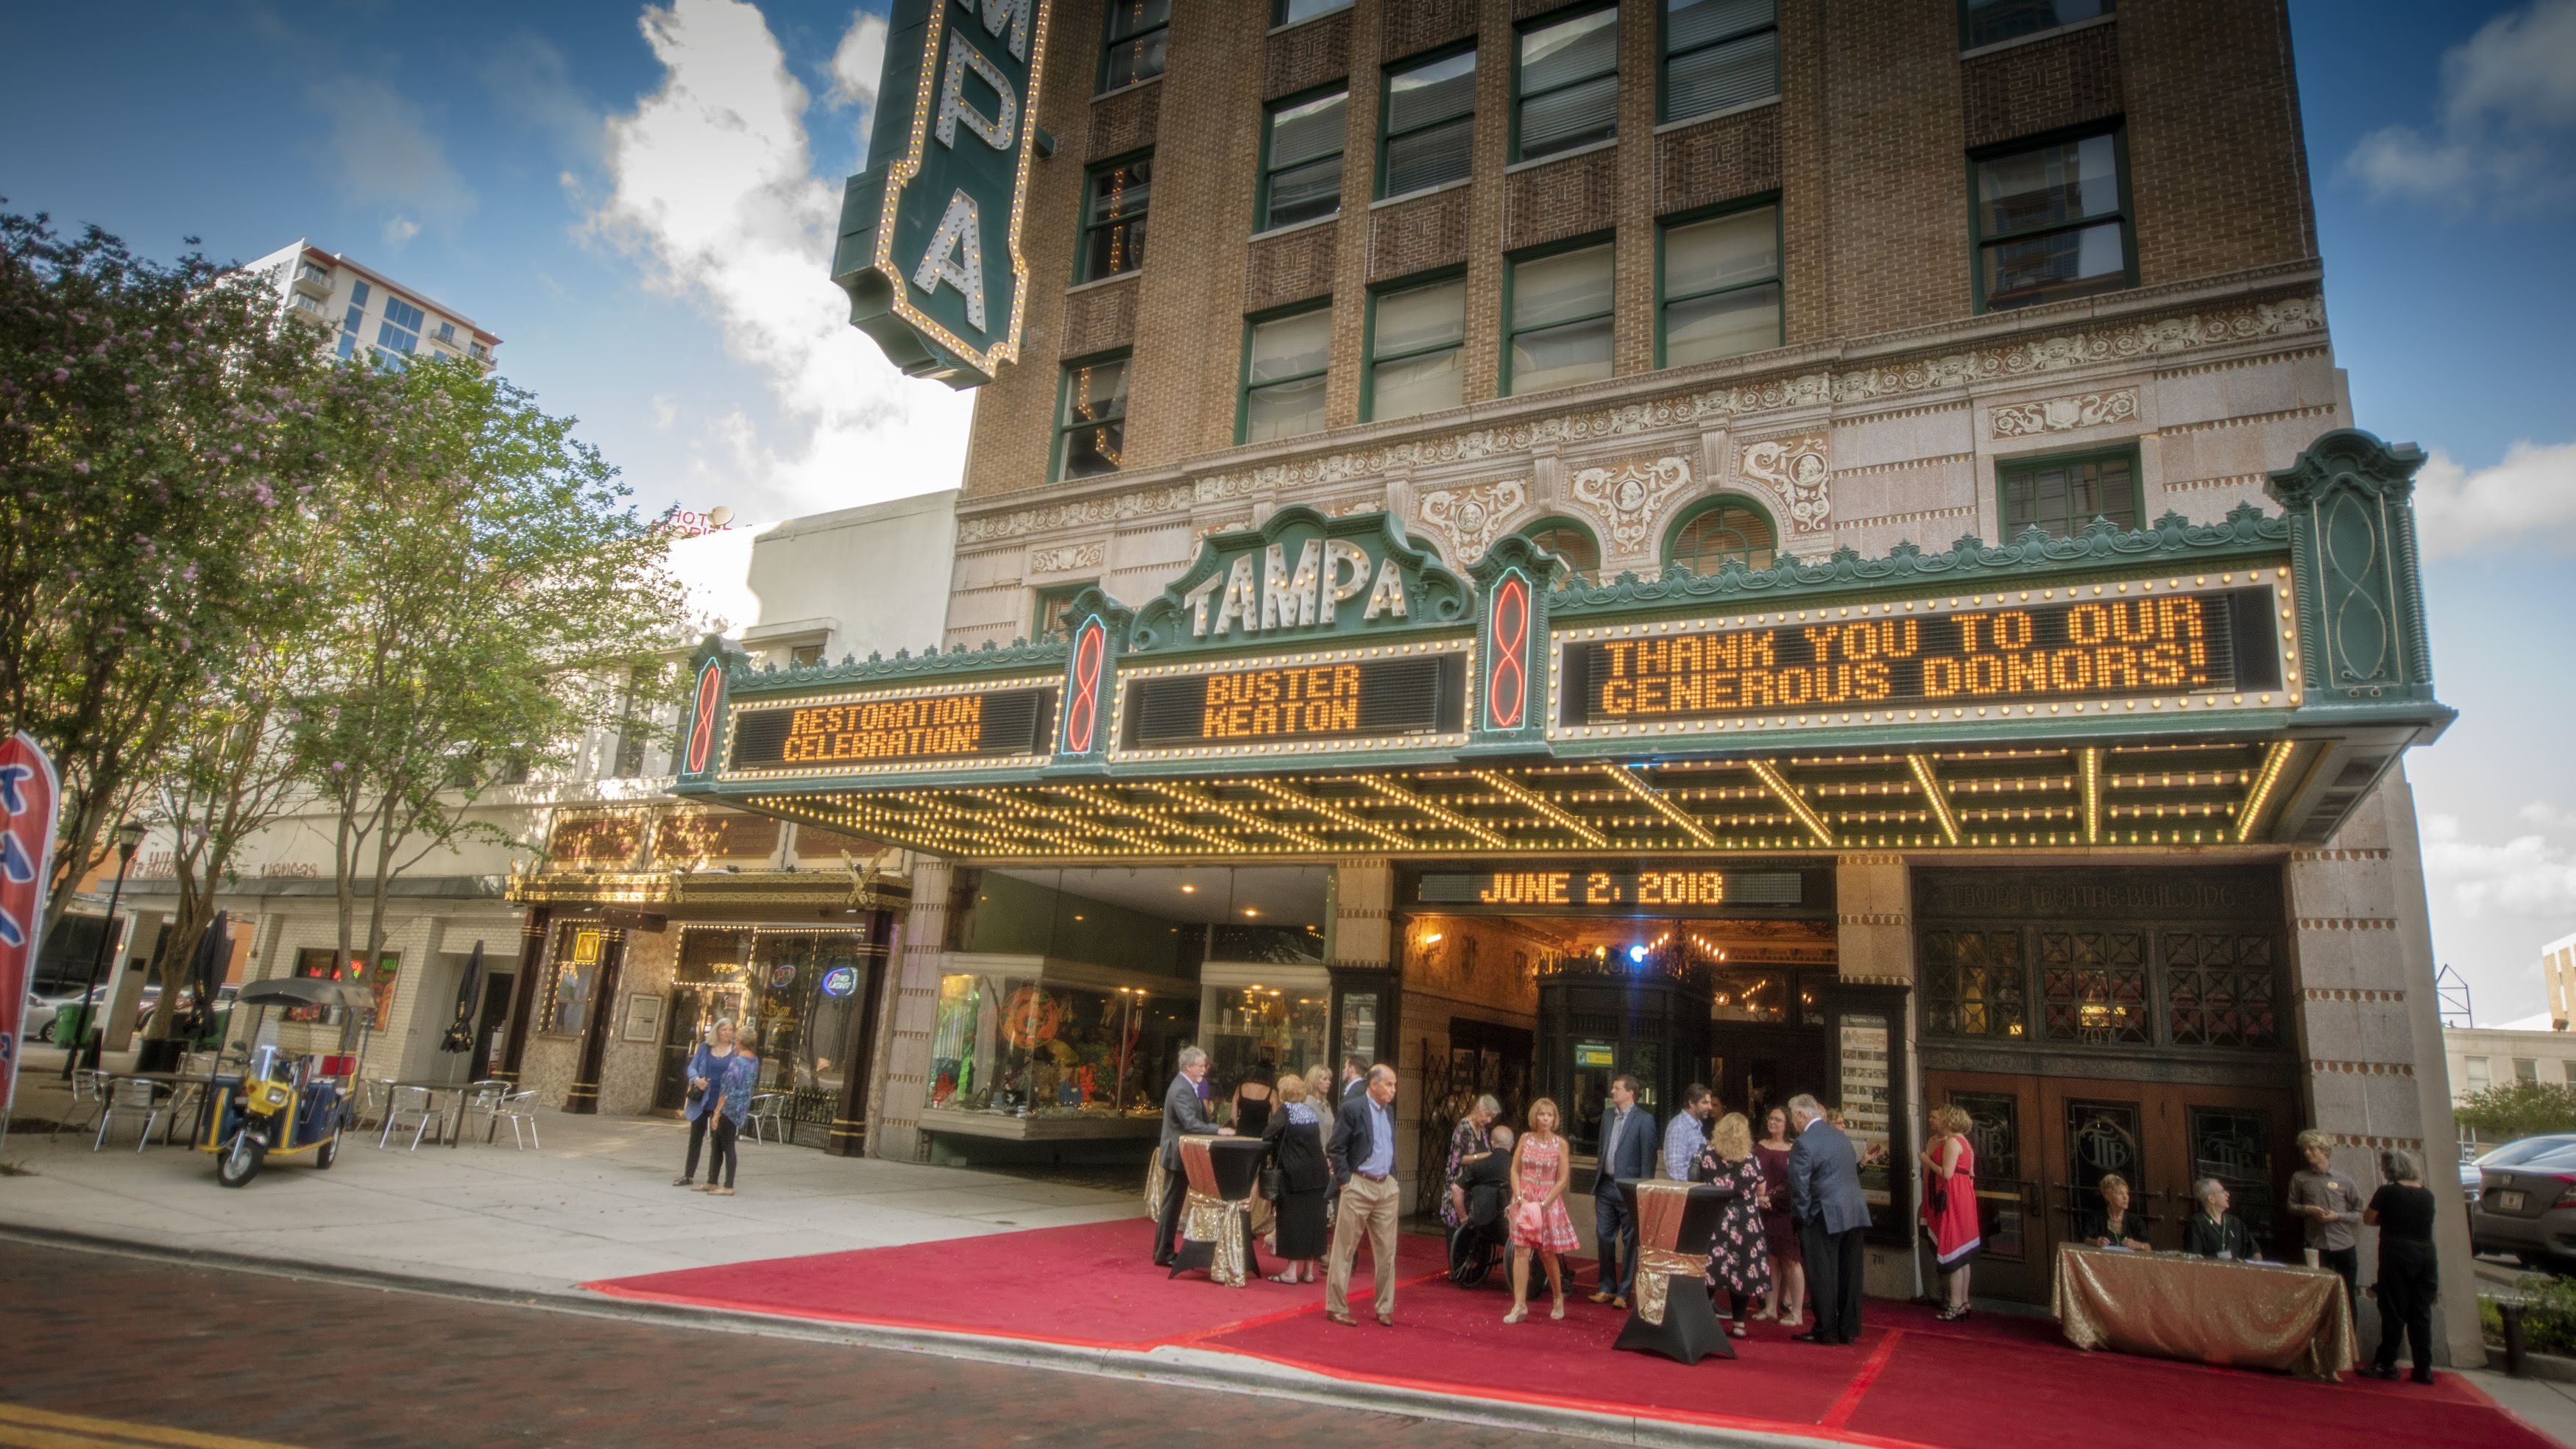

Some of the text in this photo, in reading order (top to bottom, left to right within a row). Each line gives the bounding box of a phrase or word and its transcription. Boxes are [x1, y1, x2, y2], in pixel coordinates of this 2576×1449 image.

[1184, 539, 1407, 637] TAMPA
[1604, 596, 2202, 676] THANK YOU TO OUR
[1206, 665, 1359, 705] BUSTER
[1602, 641, 2207, 714] GENEROUS DONORS!
[791, 695, 982, 735] RESTORATION
[1203, 698, 1358, 737] KEATON
[783, 724, 980, 761] CELEBRATION!
[1481, 872, 1723, 904] JUNE 2, 2018
